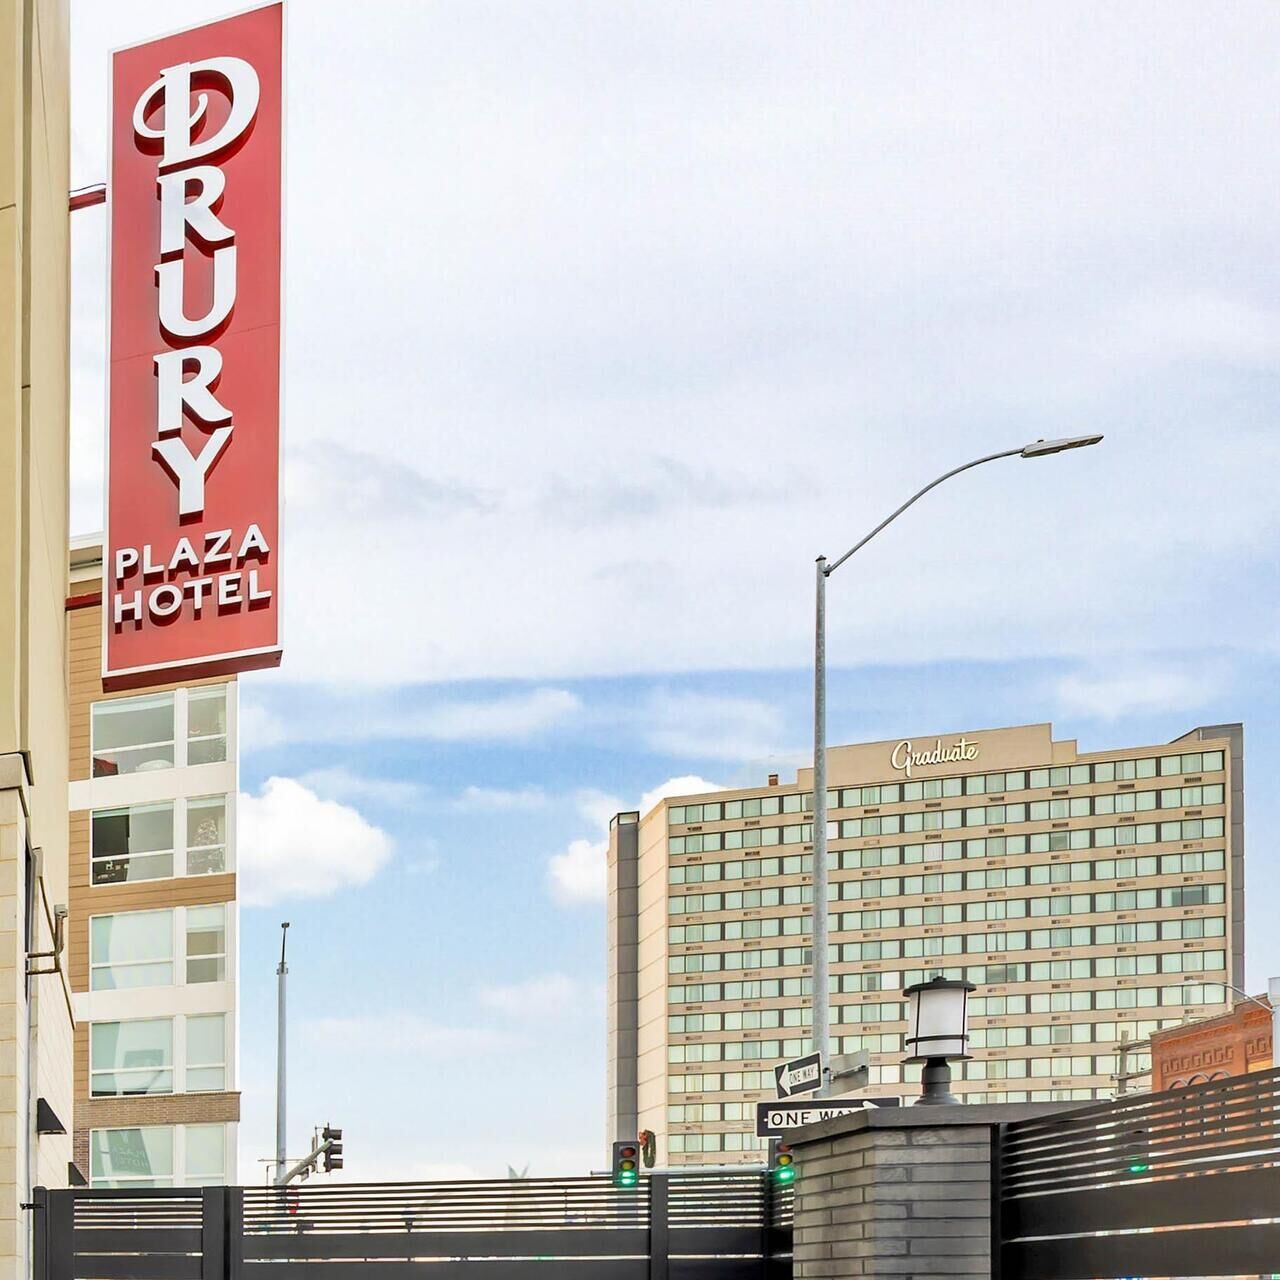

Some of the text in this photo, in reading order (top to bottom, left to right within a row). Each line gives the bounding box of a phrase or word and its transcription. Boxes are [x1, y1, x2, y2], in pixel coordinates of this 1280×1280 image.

[132, 56, 260, 514] DRURY
[115, 524, 270, 579] PLAZA
[114, 570, 272, 623] HOTEL
[891, 738, 979, 777] Graduate
[789, 1070, 801, 1085] ONE
[771, 1111, 811, 1126] ONE
